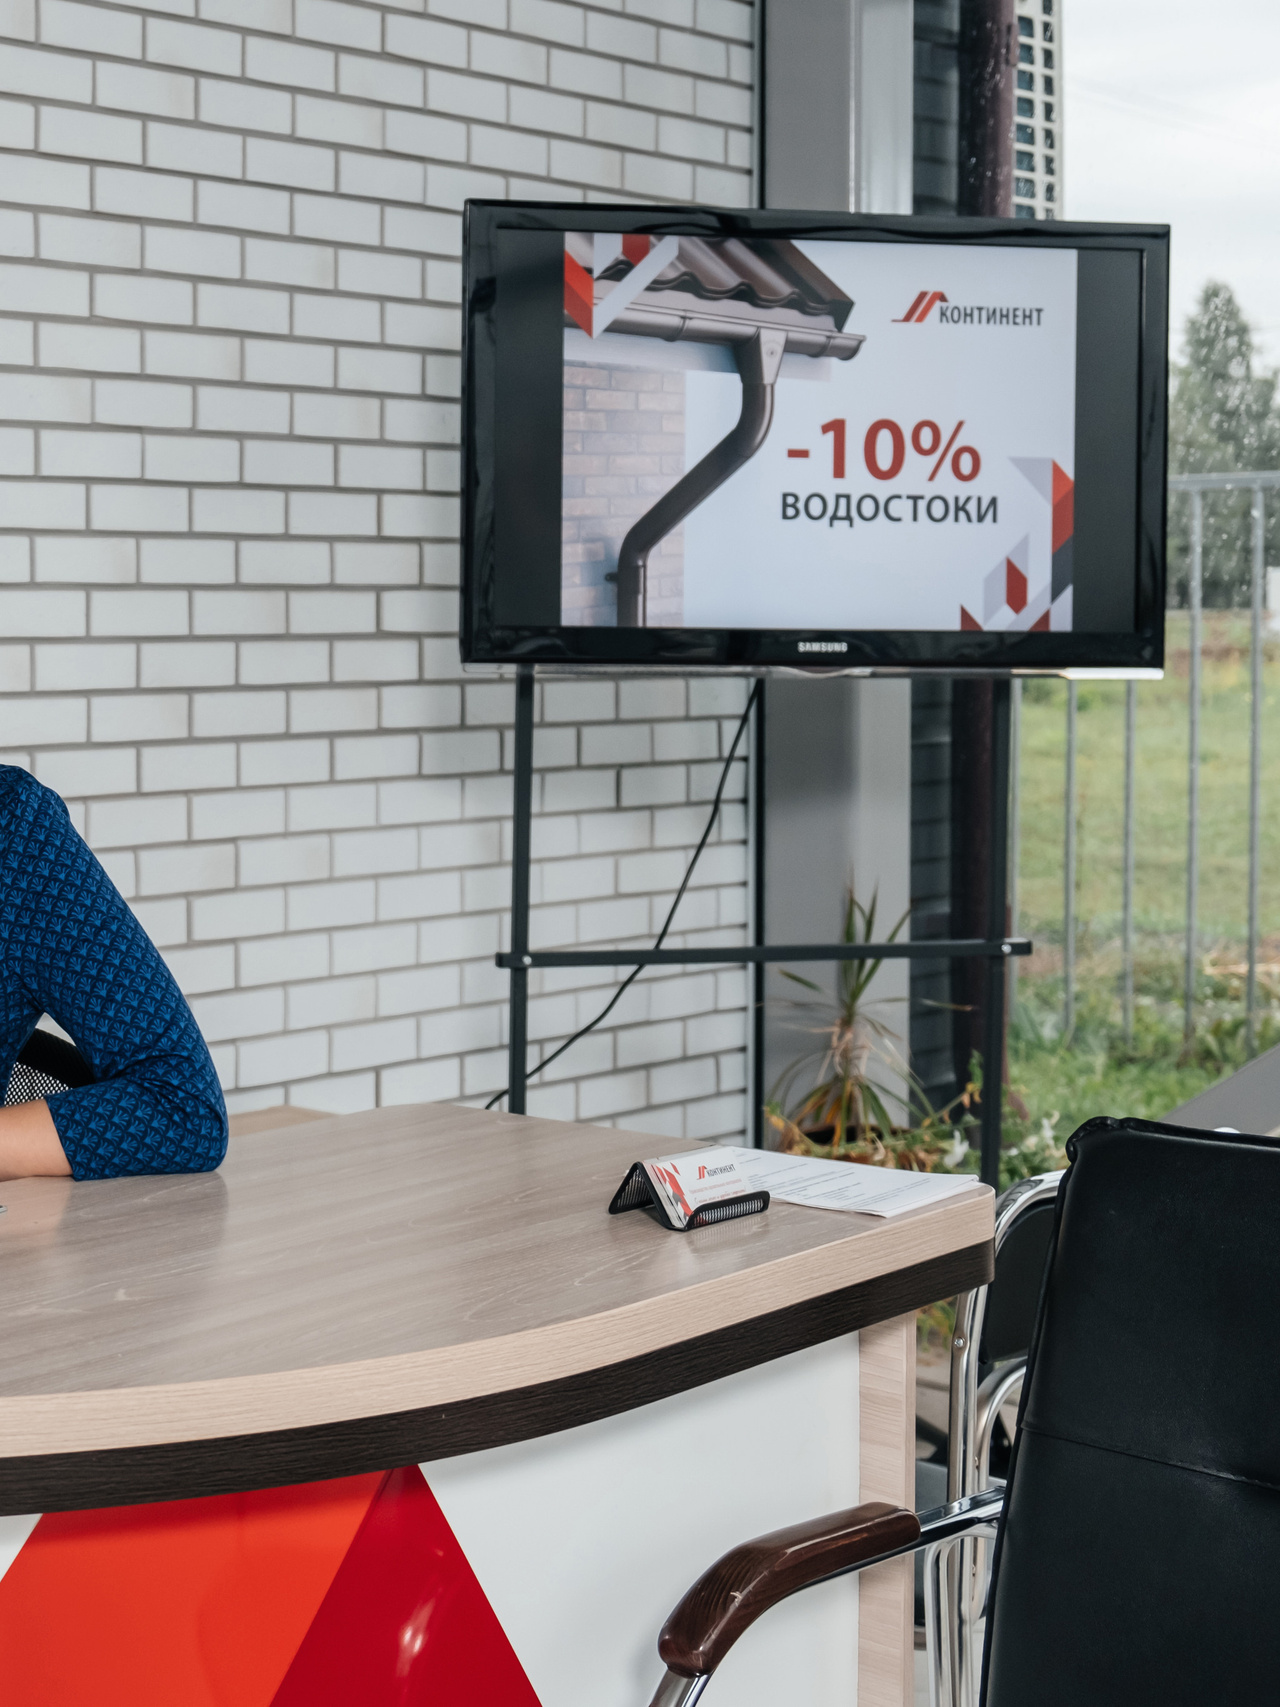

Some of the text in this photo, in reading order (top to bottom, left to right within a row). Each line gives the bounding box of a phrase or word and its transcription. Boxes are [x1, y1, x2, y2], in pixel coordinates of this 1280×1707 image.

[939, 305, 1044, 326] КОНТИНЕНТ
[787, 418, 981, 482] -10%
[781, 492, 998, 528] ВОДОСТОКИ
[797, 641, 848, 653] SAMSUNG
